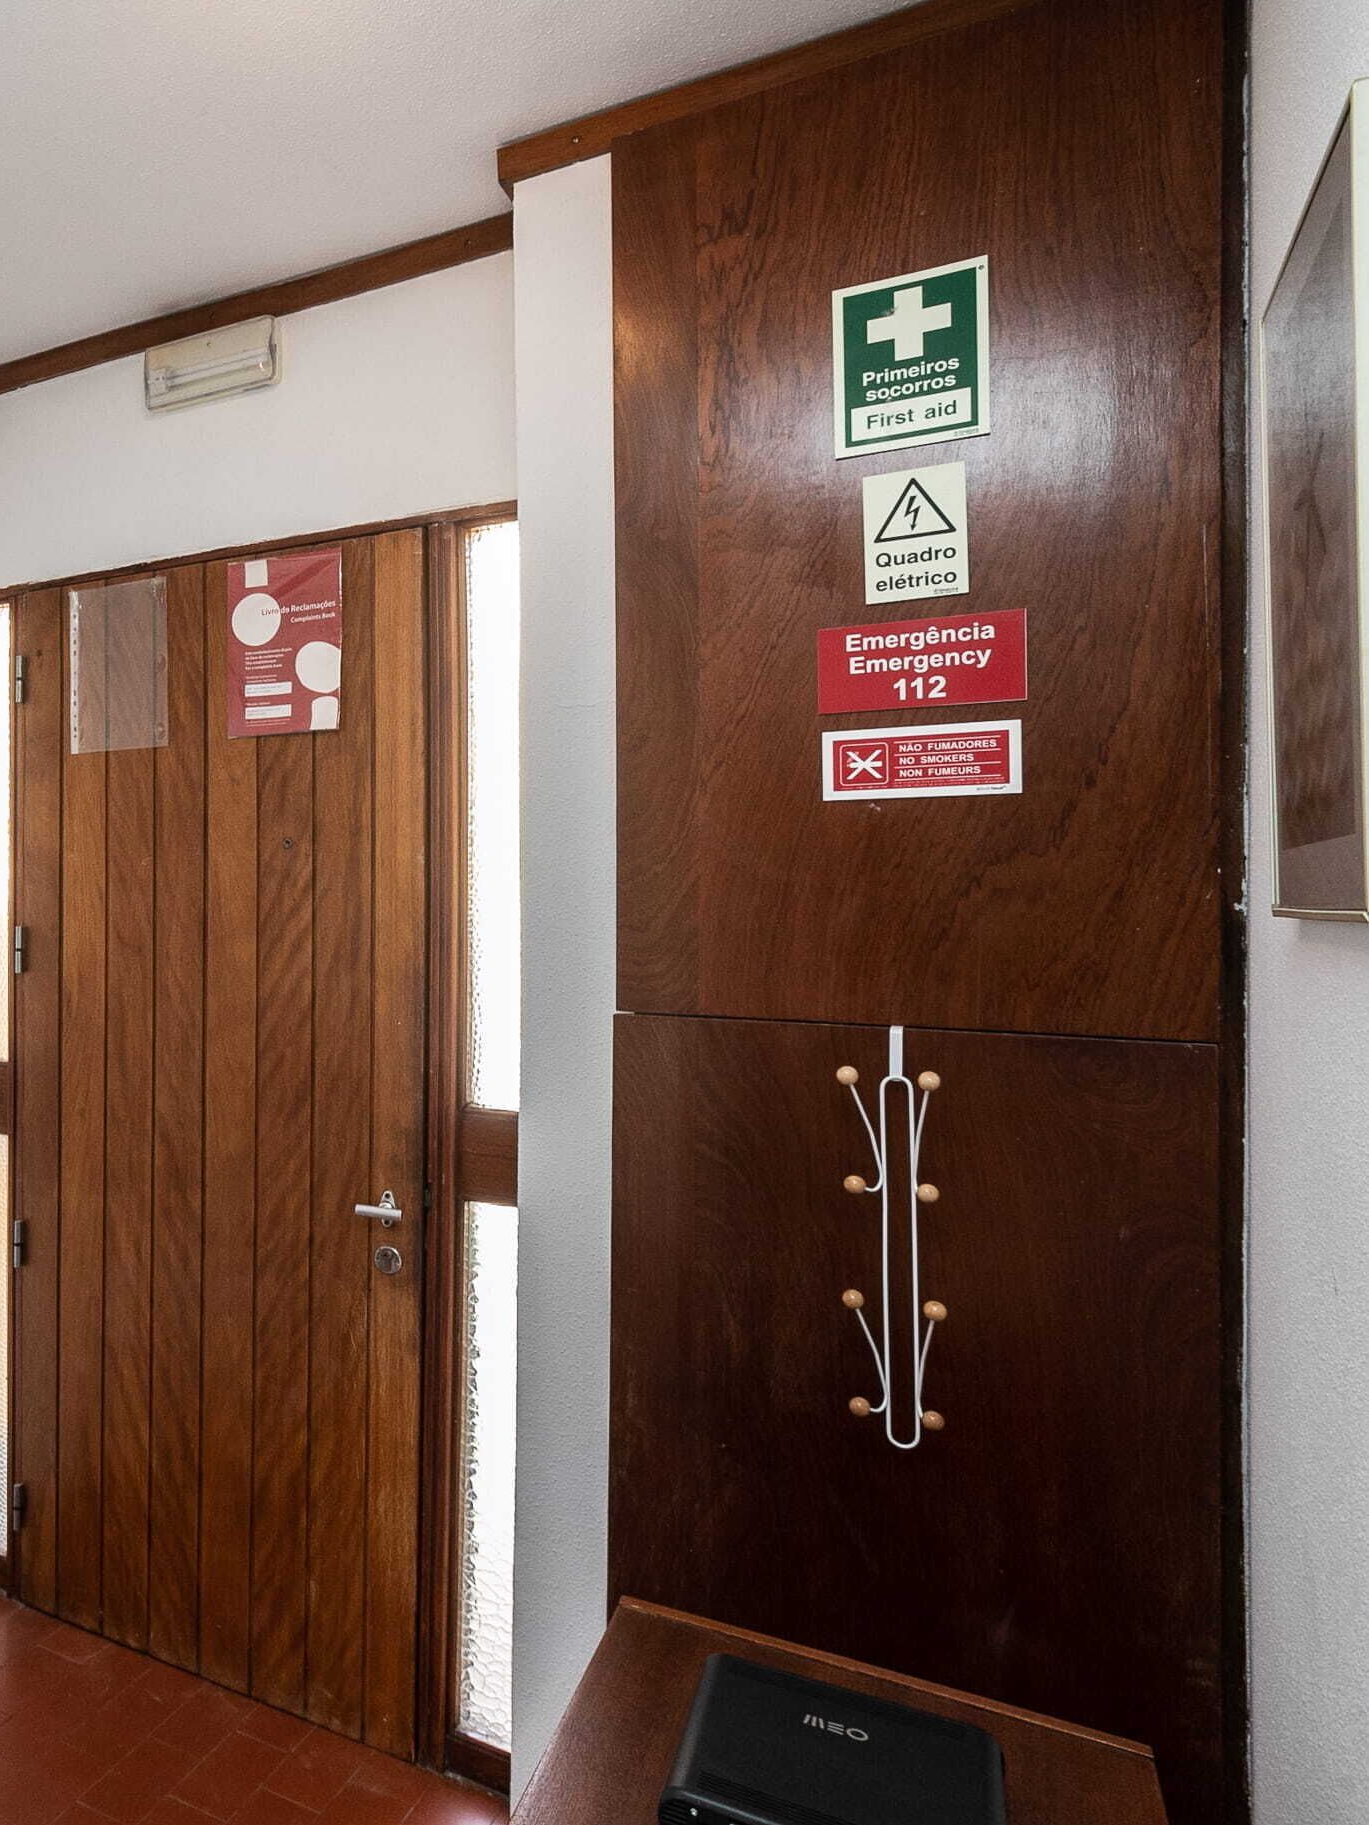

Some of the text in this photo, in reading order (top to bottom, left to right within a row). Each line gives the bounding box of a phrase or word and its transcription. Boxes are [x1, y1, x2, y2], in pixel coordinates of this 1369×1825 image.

[862, 357, 960, 387] Primeiros
[865, 374, 957, 402] socorros
[867, 399, 957, 430] First aid
[875, 546, 957, 568] Quadro
[875, 571, 957, 592] elétrico
[845, 622, 995, 652] Emergência
[848, 649, 992, 674] Emergency
[893, 675, 947, 700] 112
[898, 739, 997, 753] NÃO FUMADORES
[899, 753, 974, 765] NO SMOKERS
[899, 766, 981, 777] NON FUMEURS
[803, 1714, 869, 1741] MEO
